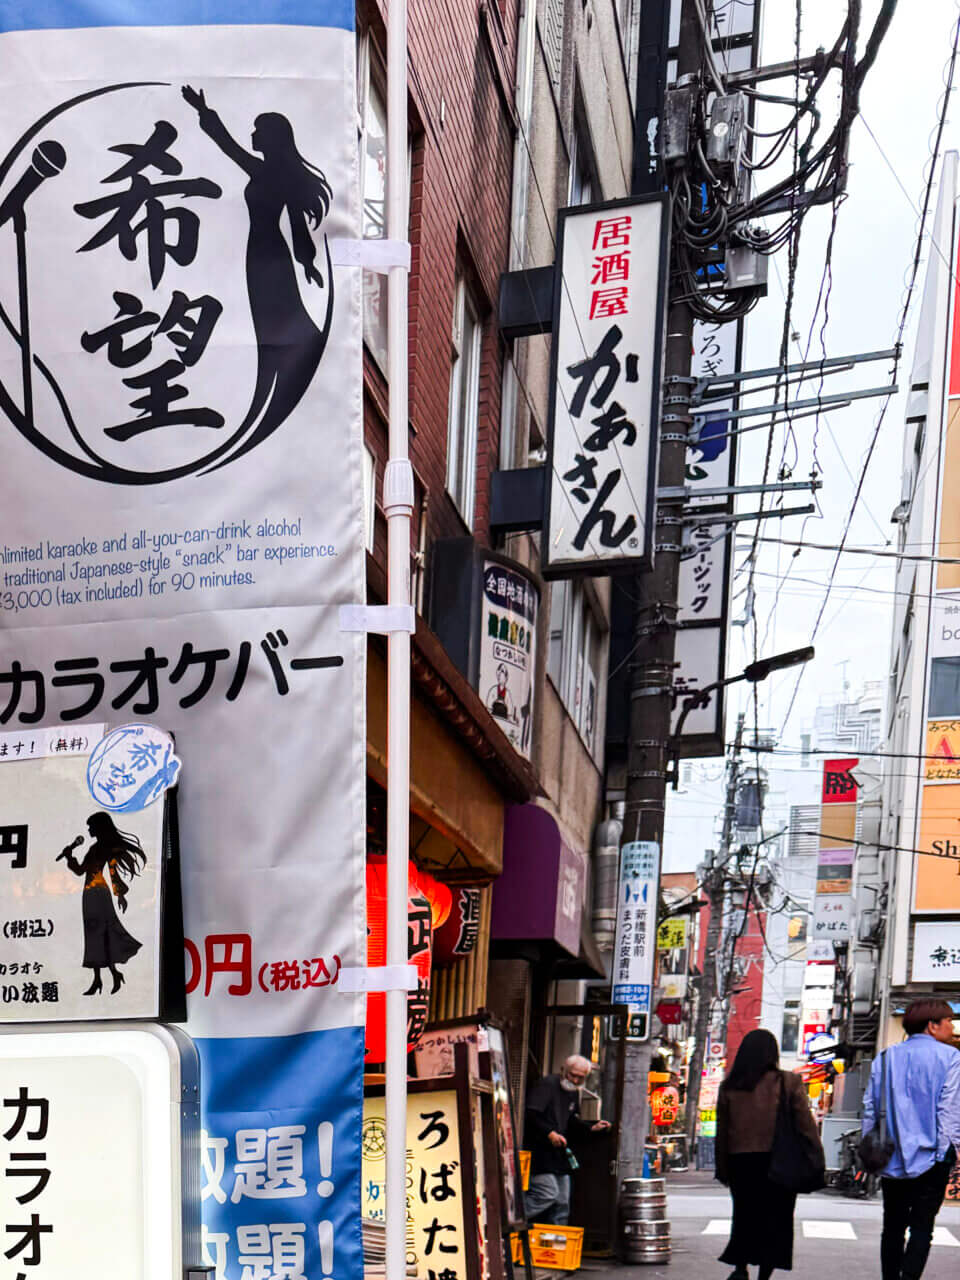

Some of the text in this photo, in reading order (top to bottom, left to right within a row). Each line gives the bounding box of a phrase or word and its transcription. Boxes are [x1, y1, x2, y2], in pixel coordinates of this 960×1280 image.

[73, 120, 225, 442] 希望
[588, 215, 632, 320] 居酒屋
[563, 324, 639, 551] かあさん
[46, 540, 98, 560] karaoke
[102, 533, 127, 553] and
[132, 520, 252, 553] all-you-can-drink
[256, 518, 302, 537] alcohol
[3, 564, 66, 586] traditional
[70, 555, 170, 583] Japanese-style
[236, 543, 258, 563] bar
[263, 543, 339, 563] experience.
[55, 583, 82, 608] (tax
[85, 578, 144, 605] included)
[148, 575, 167, 595] for
[170, 572, 196, 592] 90
[199, 569, 256, 589] minutes.
[3, 918, 54, 939] (税込)
